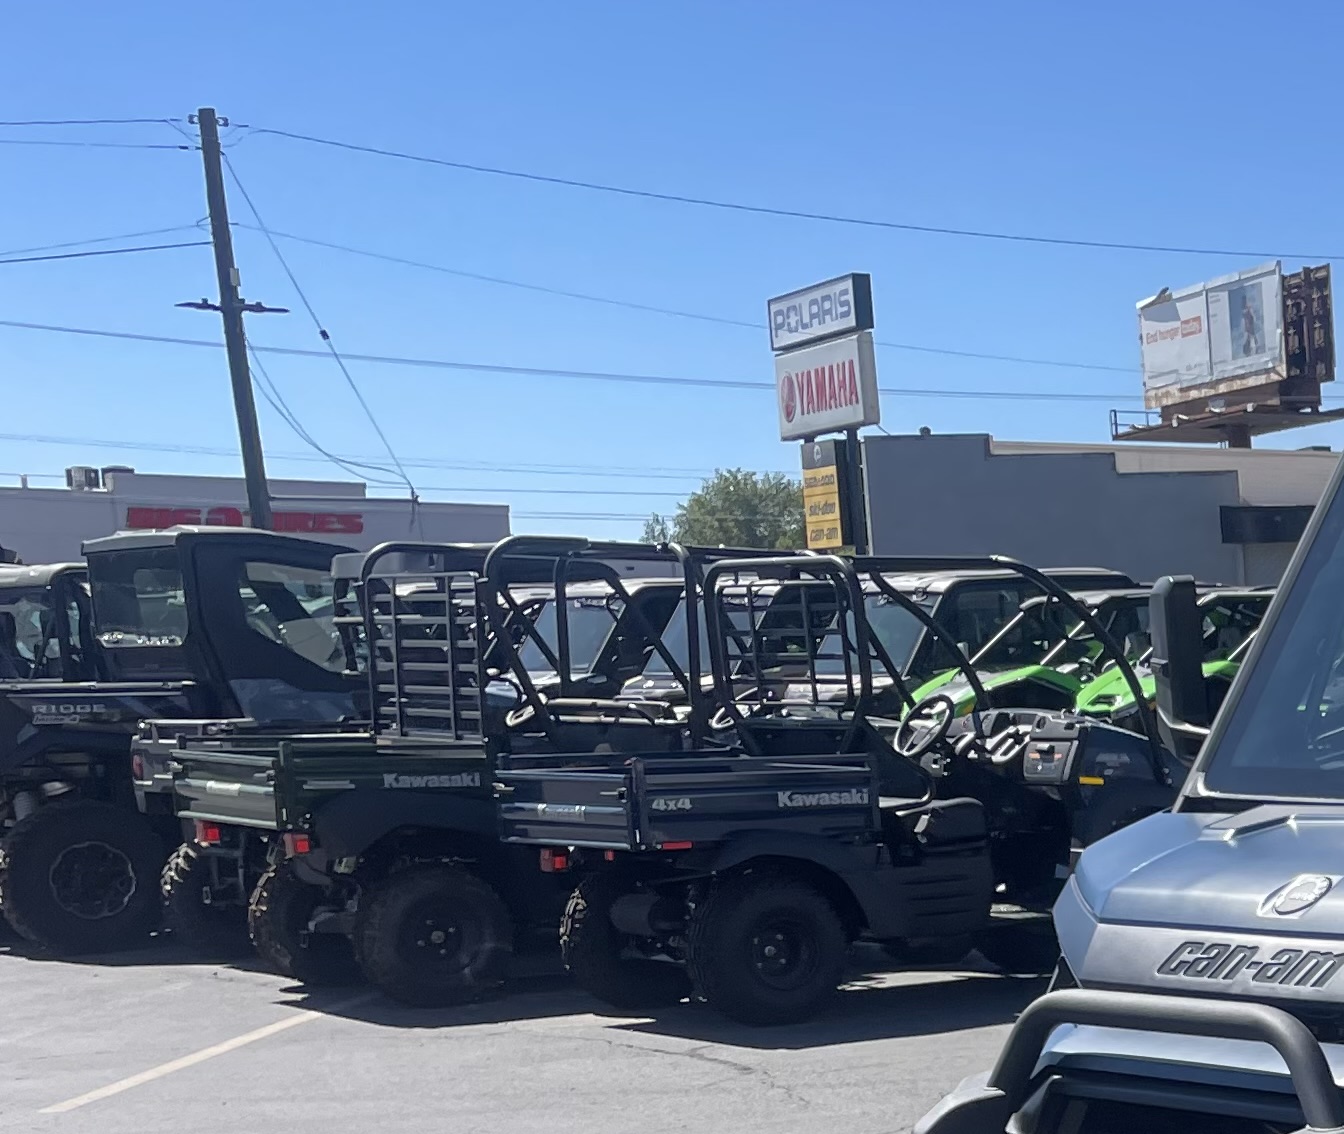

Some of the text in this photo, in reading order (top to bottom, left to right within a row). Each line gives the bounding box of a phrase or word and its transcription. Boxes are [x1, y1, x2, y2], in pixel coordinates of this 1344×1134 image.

[773, 288, 851, 338] POLARIS
[795, 358, 860, 416] YAMAHA
[383, 772, 481, 788] Kawasaki
[652, 799, 692, 811] 4x4
[777, 788, 868, 807] Kawasaki
